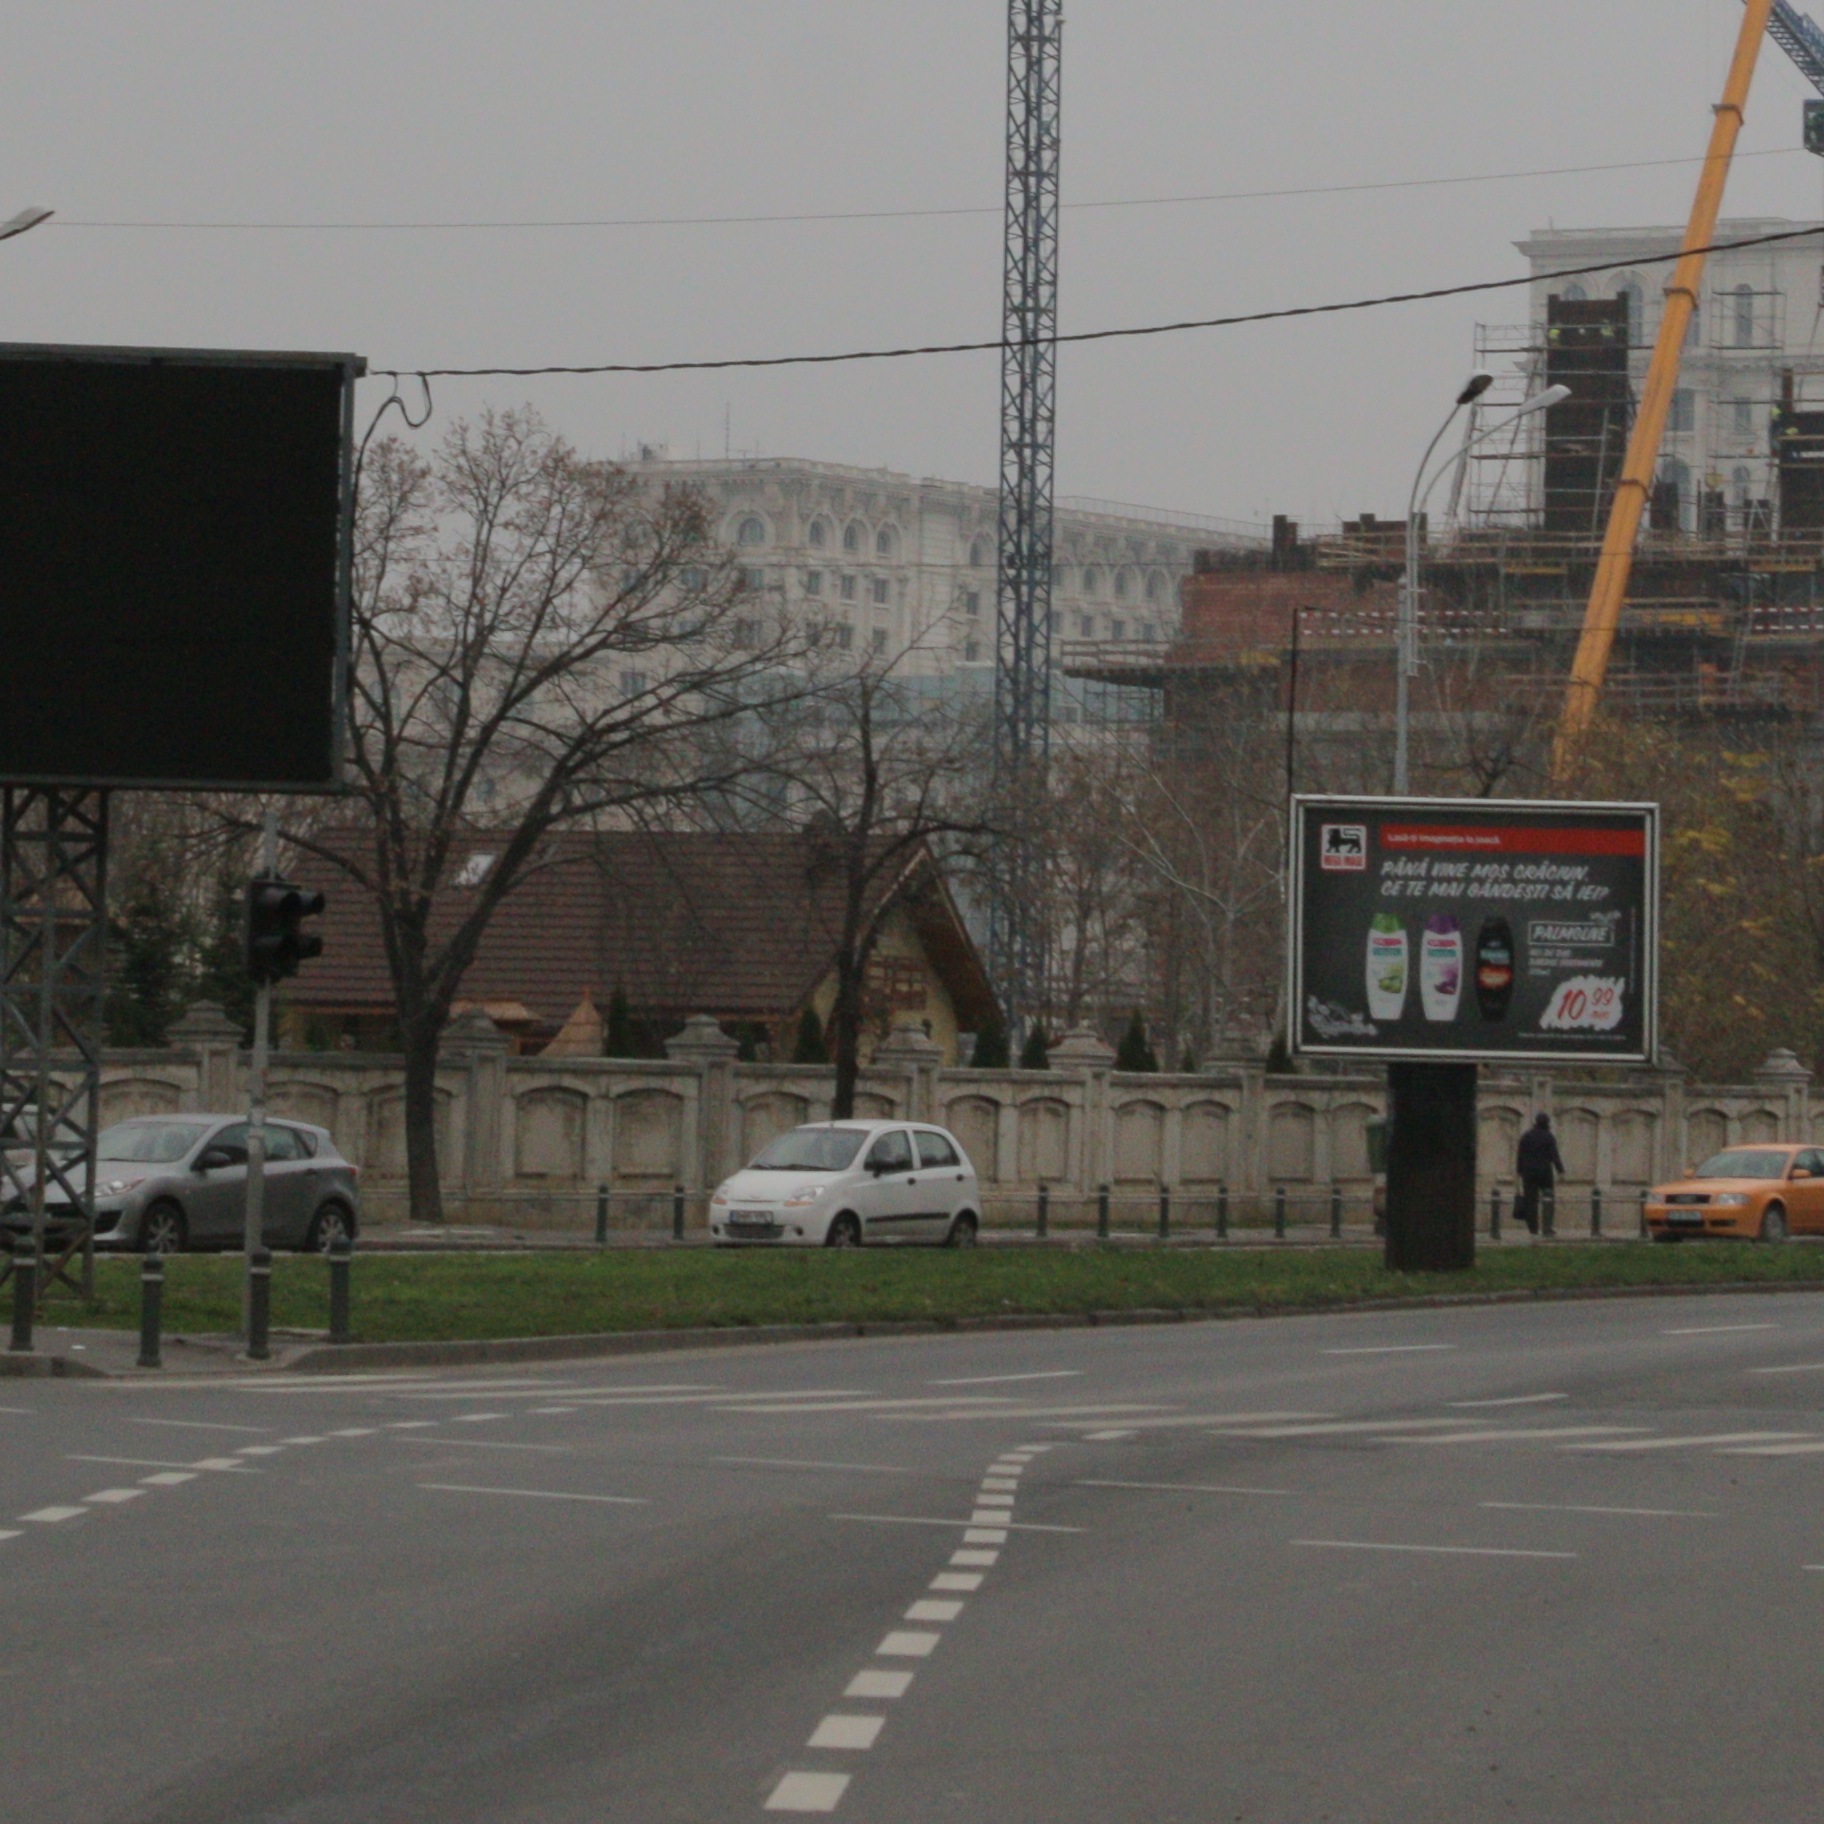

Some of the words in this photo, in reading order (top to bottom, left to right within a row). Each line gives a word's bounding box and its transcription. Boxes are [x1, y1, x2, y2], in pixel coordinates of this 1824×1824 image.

[1431, 861, 1468, 877] VINE
[1380, 880, 1404, 897] CE
[1407, 881, 1424, 898] TE
[1428, 882, 1463, 898] MAI
[1533, 925, 1609, 942] PALMOLIVE
[1557, 988, 1587, 1020] 10
[1591, 987, 1615, 1006] 99
